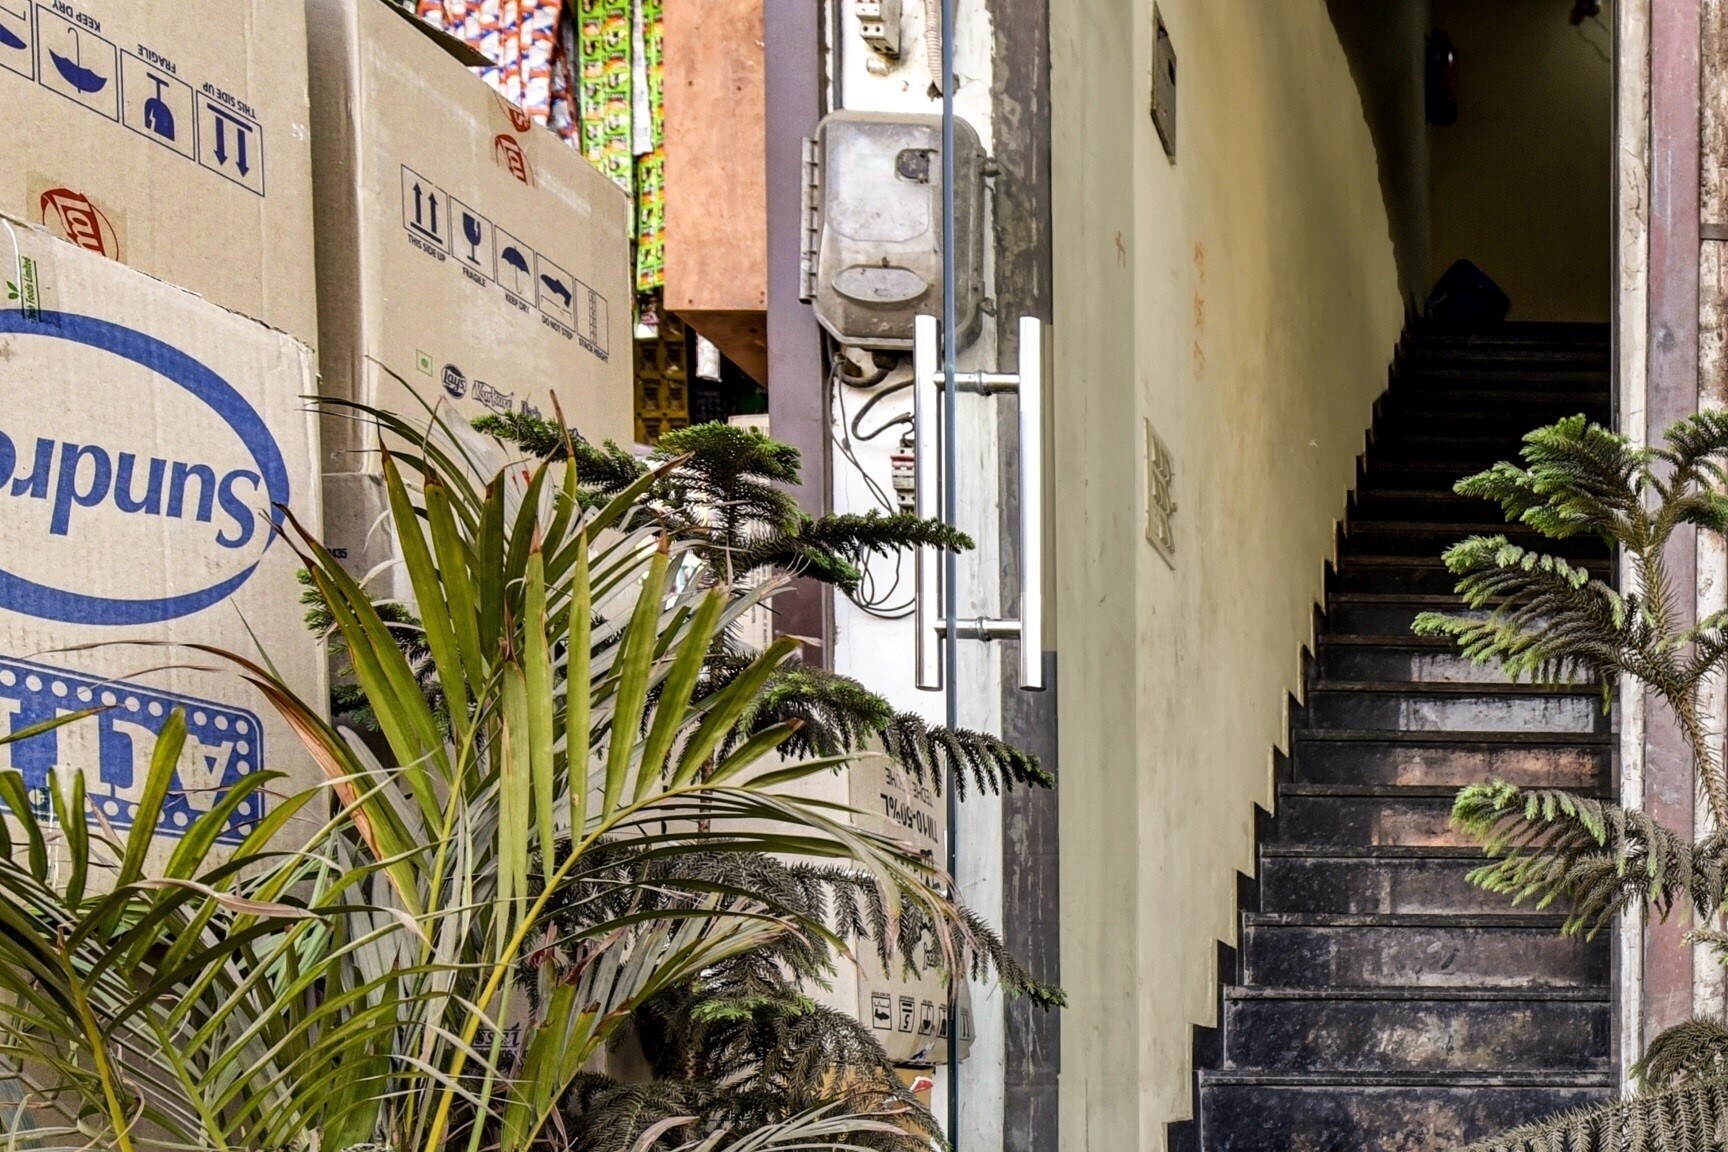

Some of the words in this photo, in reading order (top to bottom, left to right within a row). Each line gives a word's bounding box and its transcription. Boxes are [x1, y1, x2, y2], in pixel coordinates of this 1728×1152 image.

[76, 12, 101, 33] KEEP
[137, 44, 176, 75] FRAGILE
[202, 82, 216, 99] UP
[216, 89, 236, 111] SIDE
[237, 101, 257, 120] THIS
[407, 234, 422, 250] THIS
[422, 242, 437, 259] SIDE
[436, 250, 447, 263] UP
[462, 266, 487, 288] FRAGILE
